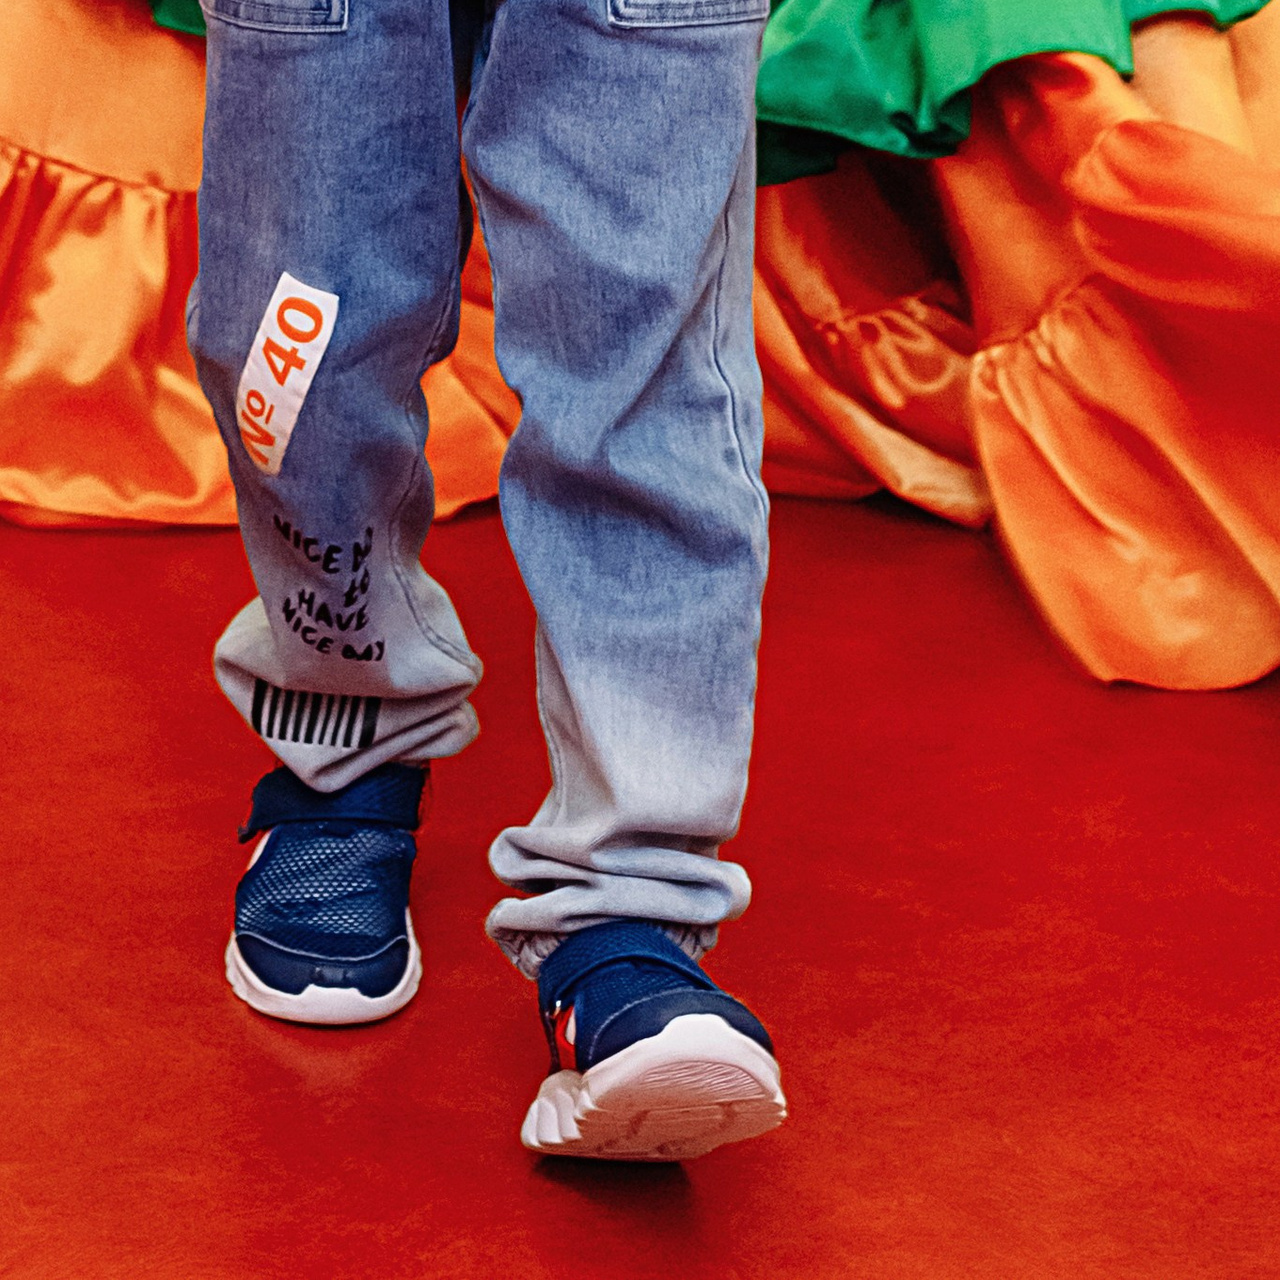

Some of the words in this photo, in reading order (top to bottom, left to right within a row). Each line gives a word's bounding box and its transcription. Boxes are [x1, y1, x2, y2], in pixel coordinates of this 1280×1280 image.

[262, 296, 324, 387] 40
[273, 513, 343, 574] NICE
[298, 589, 371, 632] HAVE
